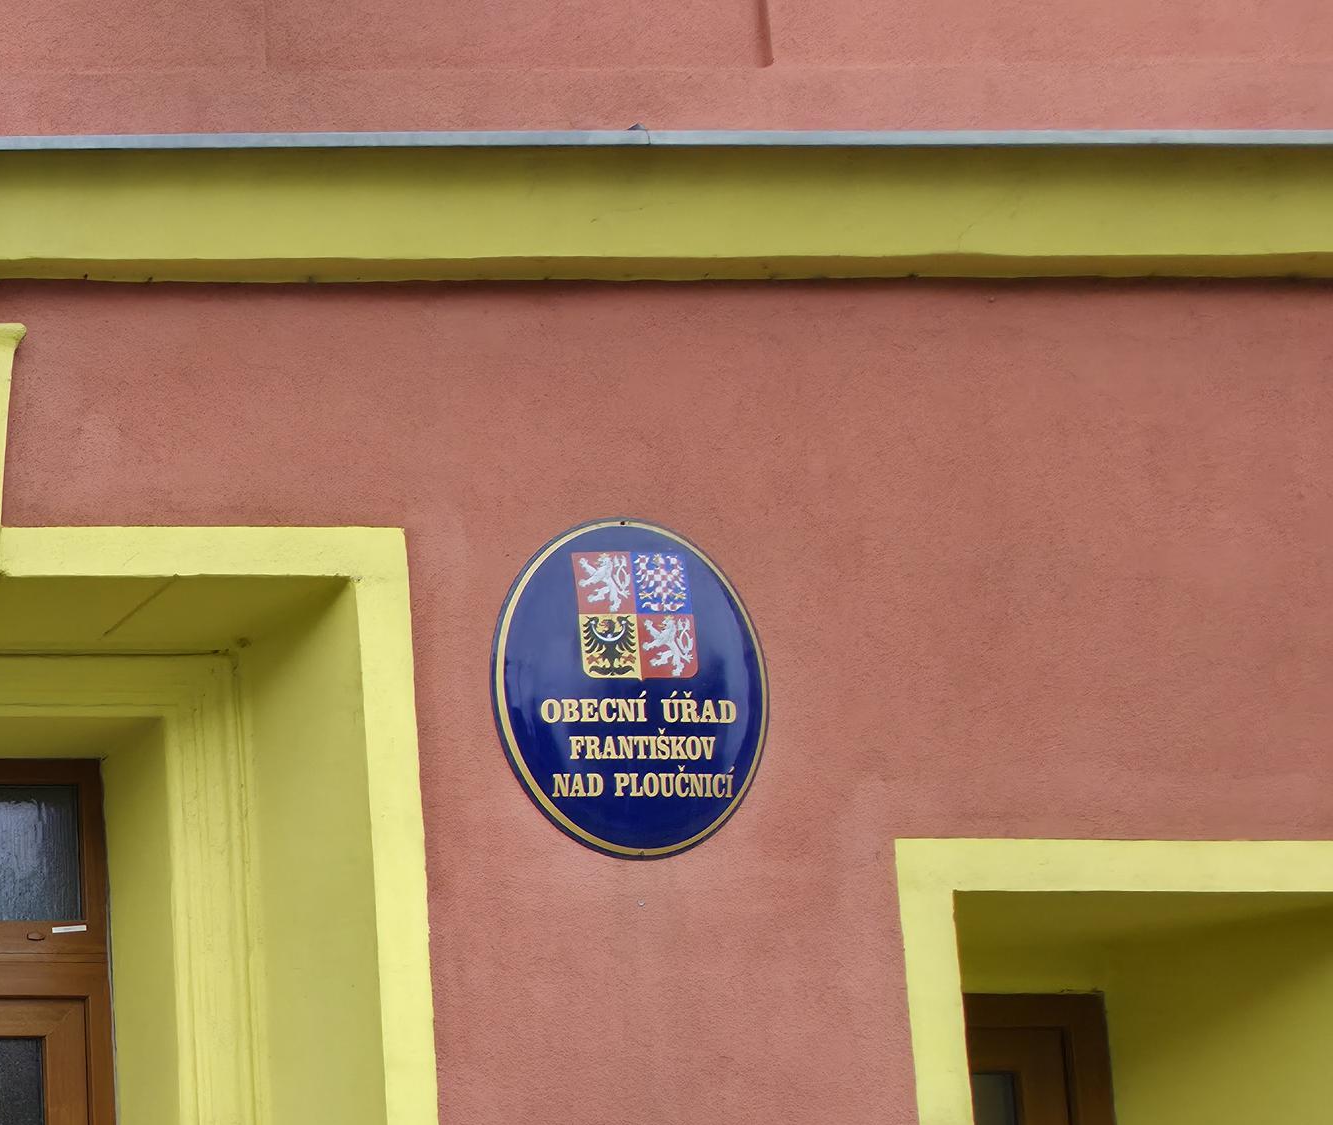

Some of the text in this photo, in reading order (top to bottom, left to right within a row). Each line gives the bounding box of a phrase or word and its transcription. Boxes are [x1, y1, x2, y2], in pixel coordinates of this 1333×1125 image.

[540, 690, 737, 723] OBECNÍ ÚŘAD
[569, 728, 716, 760] FRANTIŠKOV
[552, 765, 736, 798] NAD PLOUČNICÍ
